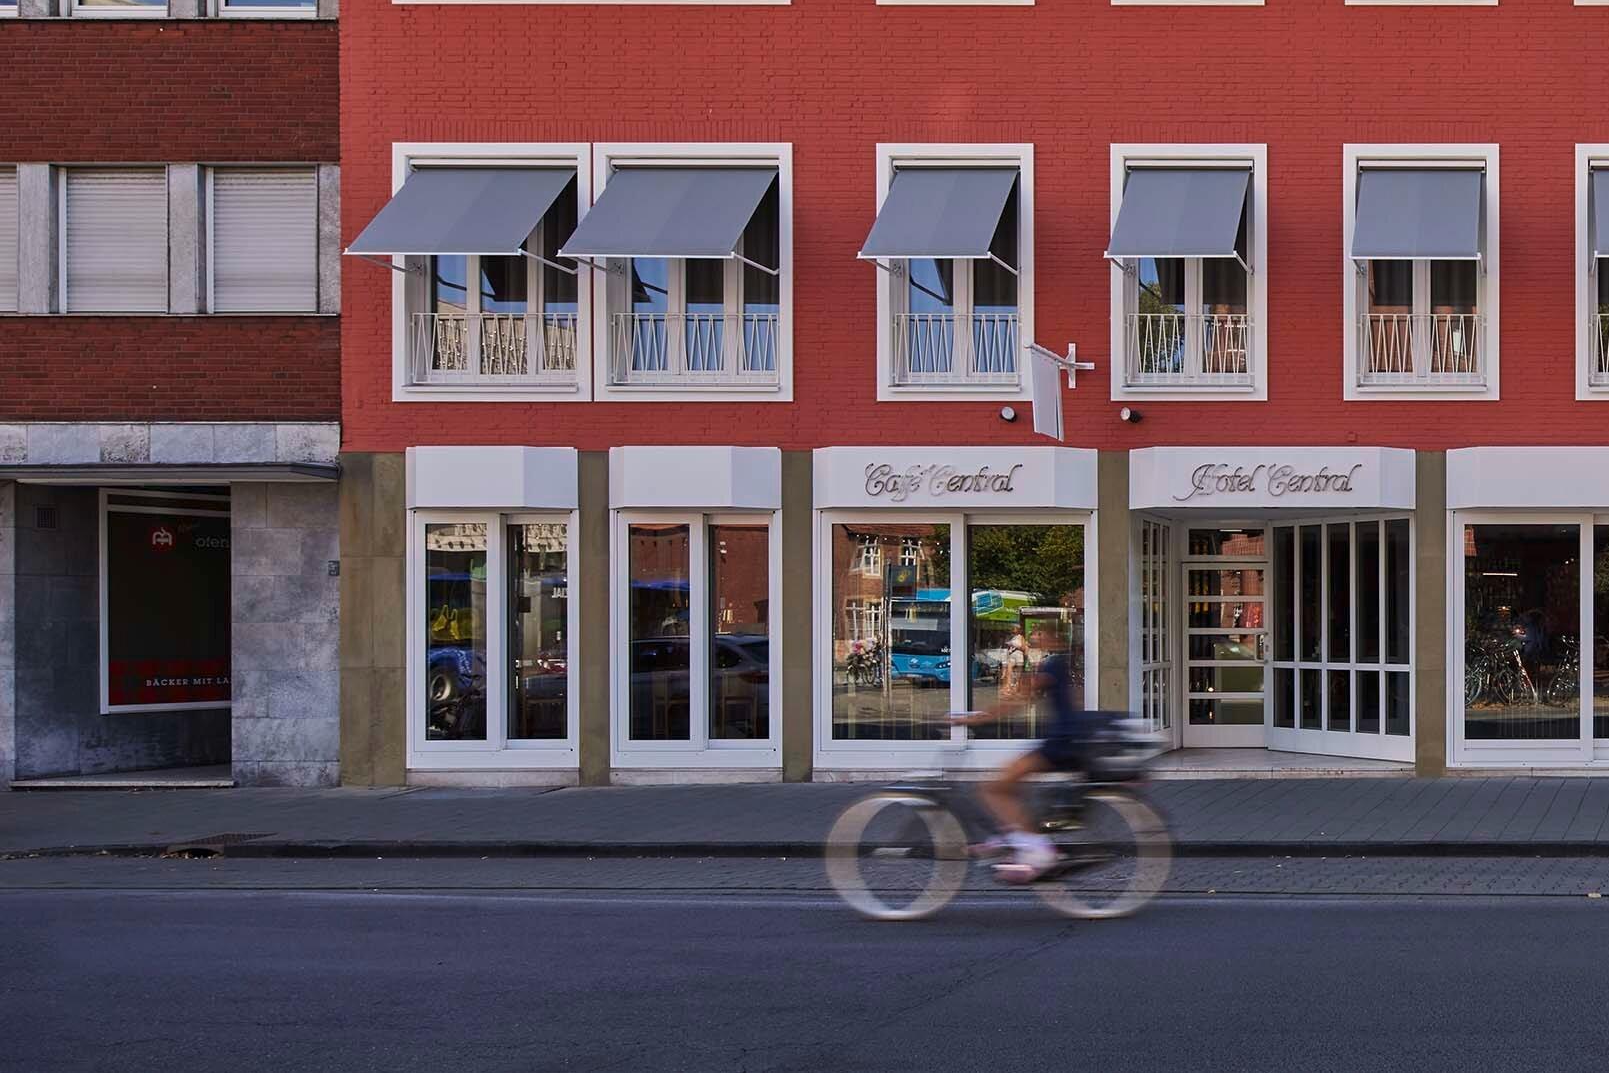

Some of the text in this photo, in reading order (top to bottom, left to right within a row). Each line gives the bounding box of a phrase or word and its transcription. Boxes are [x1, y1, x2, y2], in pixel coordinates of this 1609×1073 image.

[865, 462, 1023, 502] Café Central
[1173, 463, 1362, 502] Hotel Central
[193, 677, 212, 686] MIT
